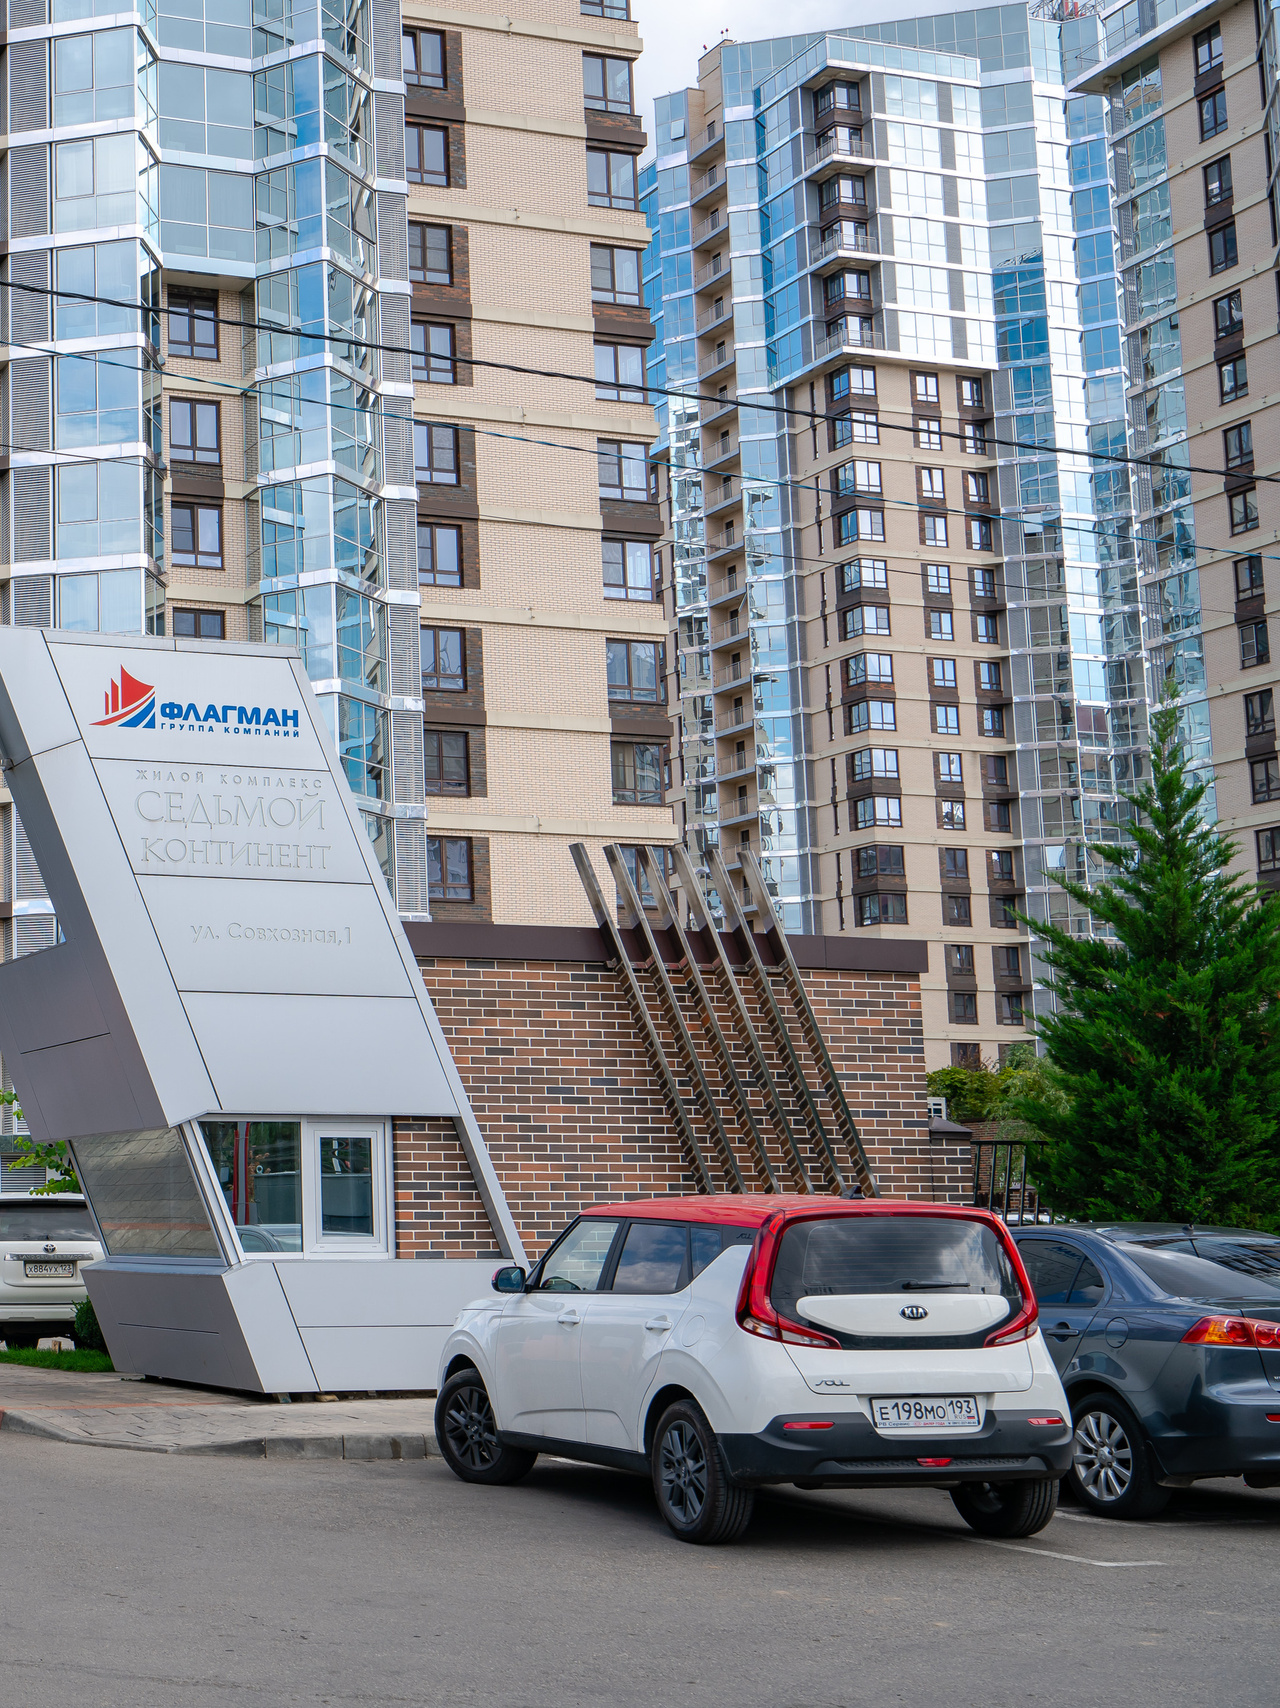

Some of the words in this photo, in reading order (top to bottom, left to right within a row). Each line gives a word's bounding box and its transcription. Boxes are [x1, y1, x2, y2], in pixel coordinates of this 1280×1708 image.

[160, 702, 299, 727] ФЛАГМАН
[161, 723, 214, 733] ГРУППА
[224, 727, 299, 738] КОМПАНИЙ
[136, 769, 204, 783] ЖИЛОЙ
[220, 774, 322, 789] КОМПЛЕКС
[135, 790, 326, 830] СЕДЬМОЙ
[141, 837, 332, 869] КОНТИНЕНТ
[190, 925, 220, 943] ул.
[903, 1306, 927, 1318] KIA
[878, 1402, 946, 1421] Е198МО
[948, 1399, 972, 1414] 193
